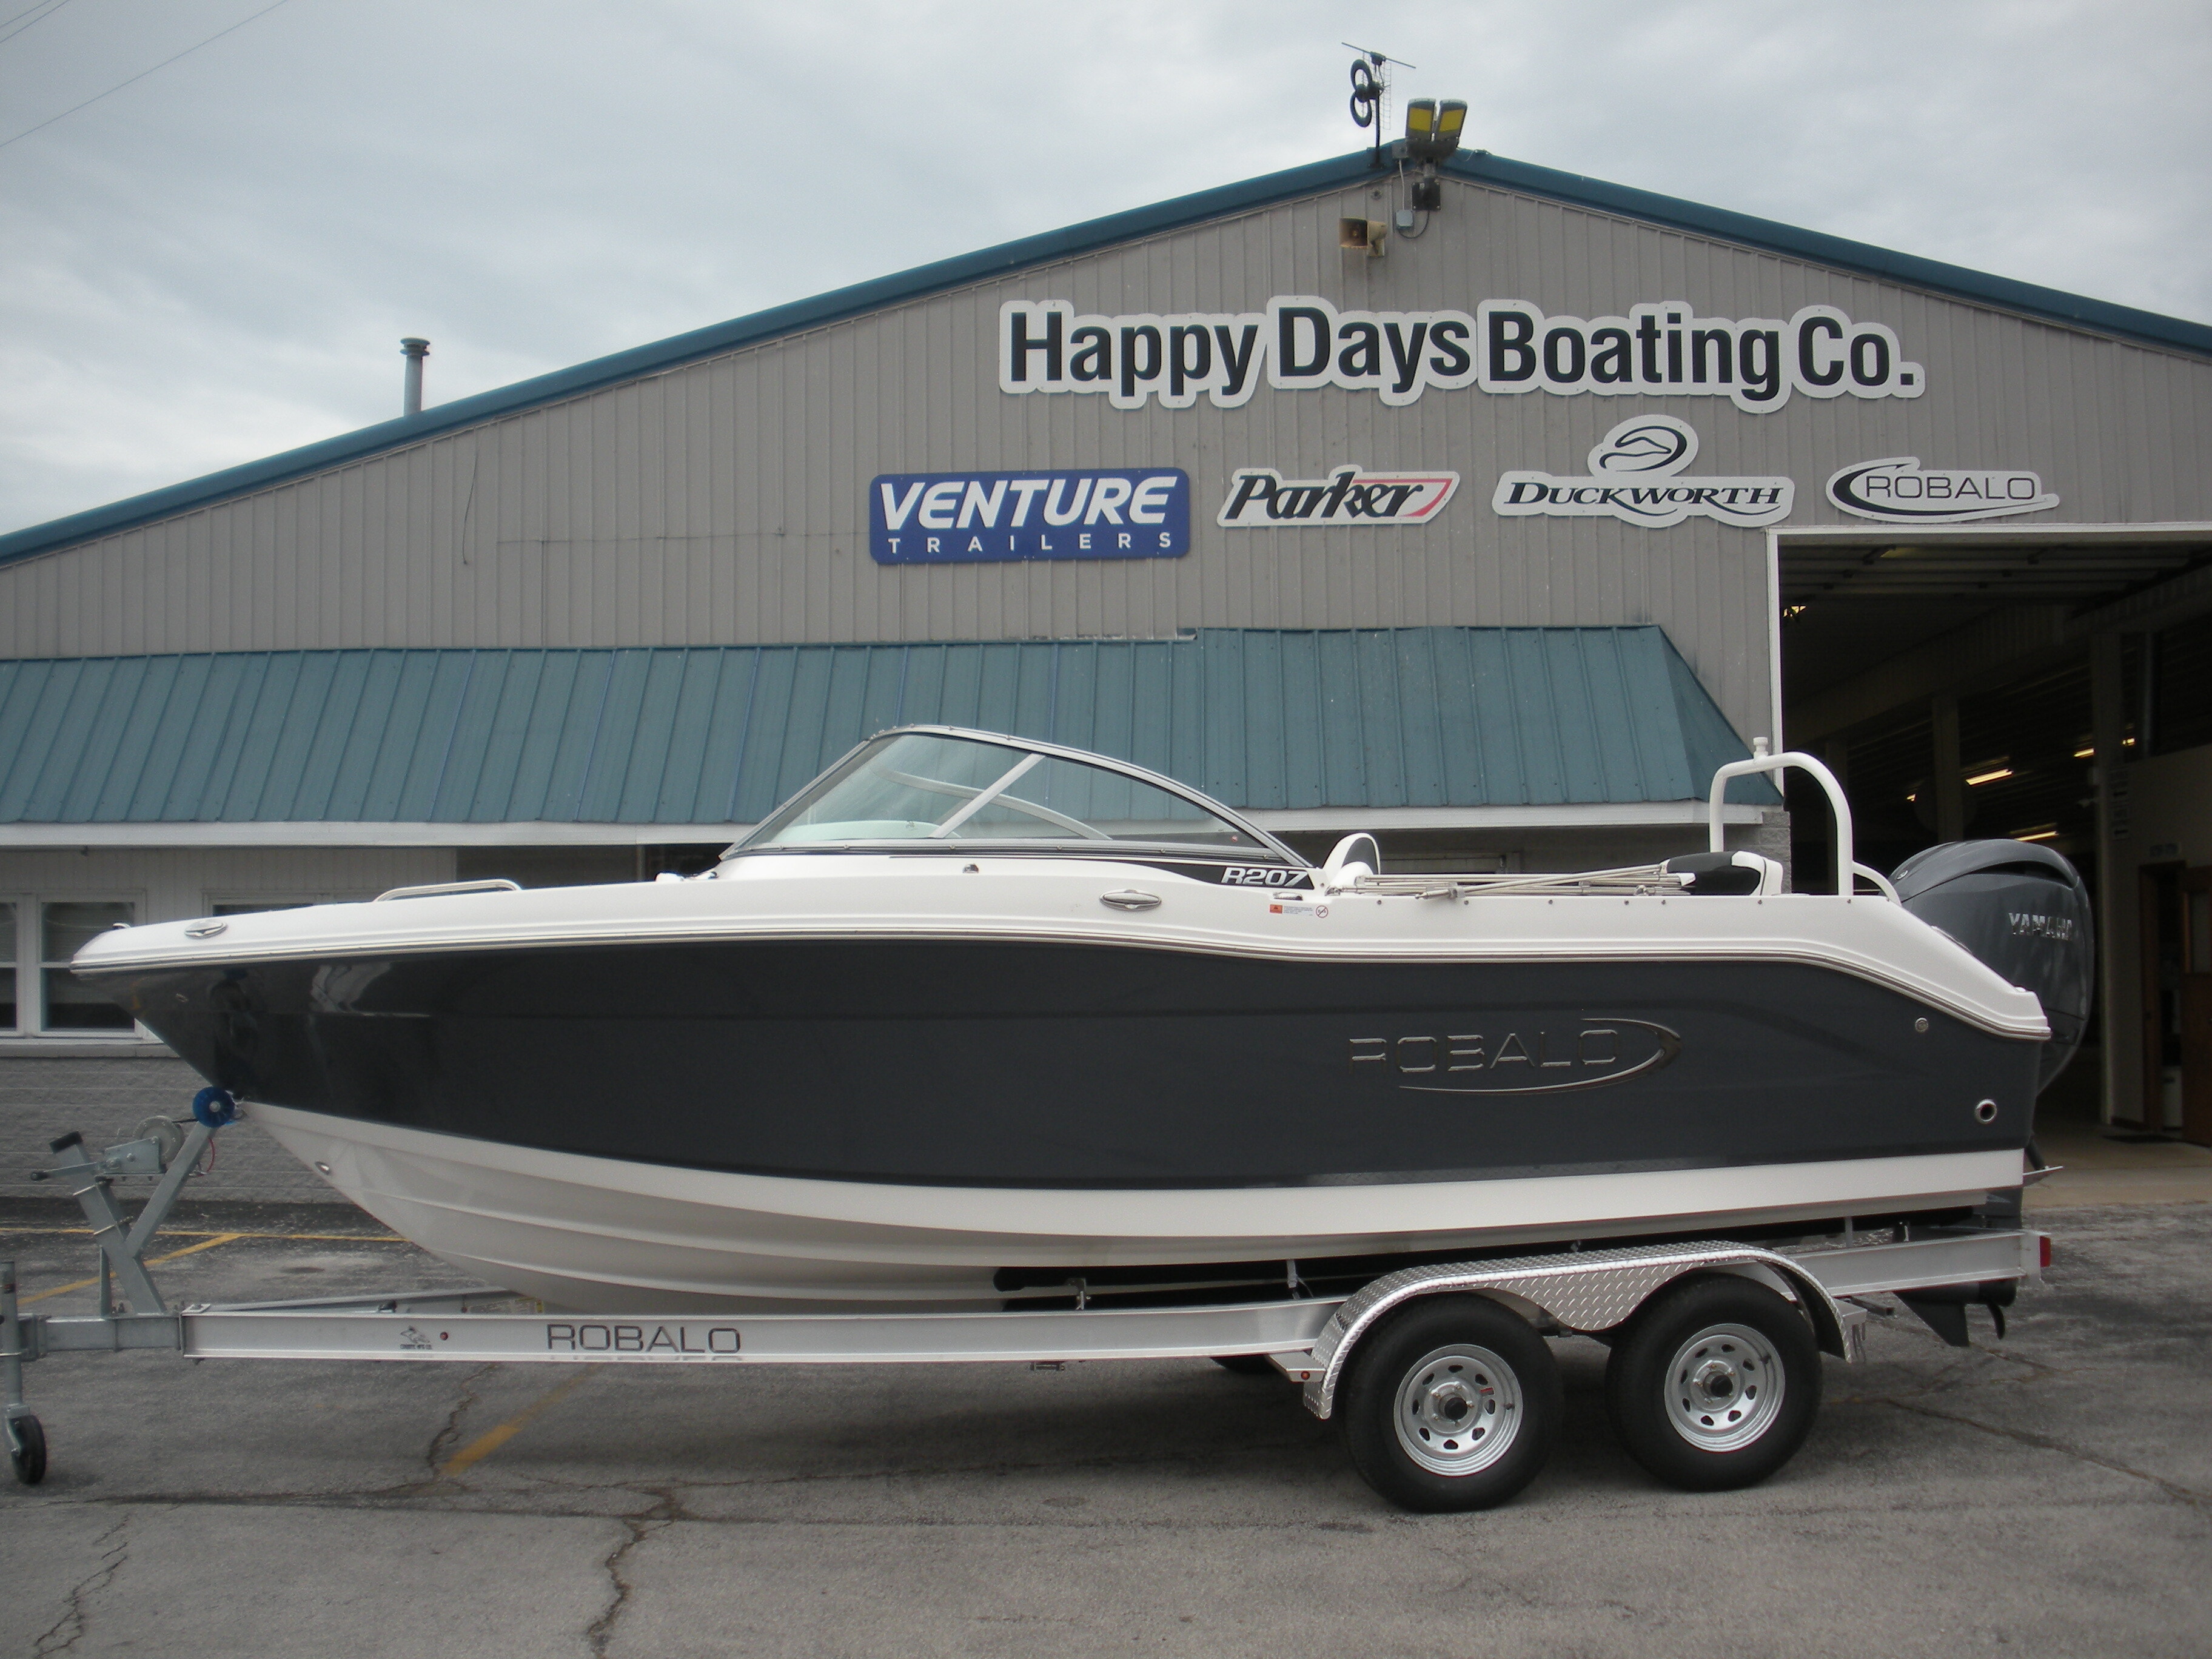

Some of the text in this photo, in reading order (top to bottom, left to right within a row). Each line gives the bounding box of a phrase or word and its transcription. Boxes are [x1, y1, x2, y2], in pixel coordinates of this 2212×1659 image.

[1011, 306, 1914, 401] Happy Days Boating Co.
[880, 476, 1178, 531] VENTURE
[1224, 471, 1424, 520] Parker
[1504, 481, 1784, 516] DUCKWORTH
[1866, 475, 2036, 500] ROBALO
[888, 532, 1171, 554] TRAILERS
[1220, 866, 1309, 888] R207
[1349, 1029, 1618, 1074] ROBALO
[546, 1324, 742, 1354] ROBALO
